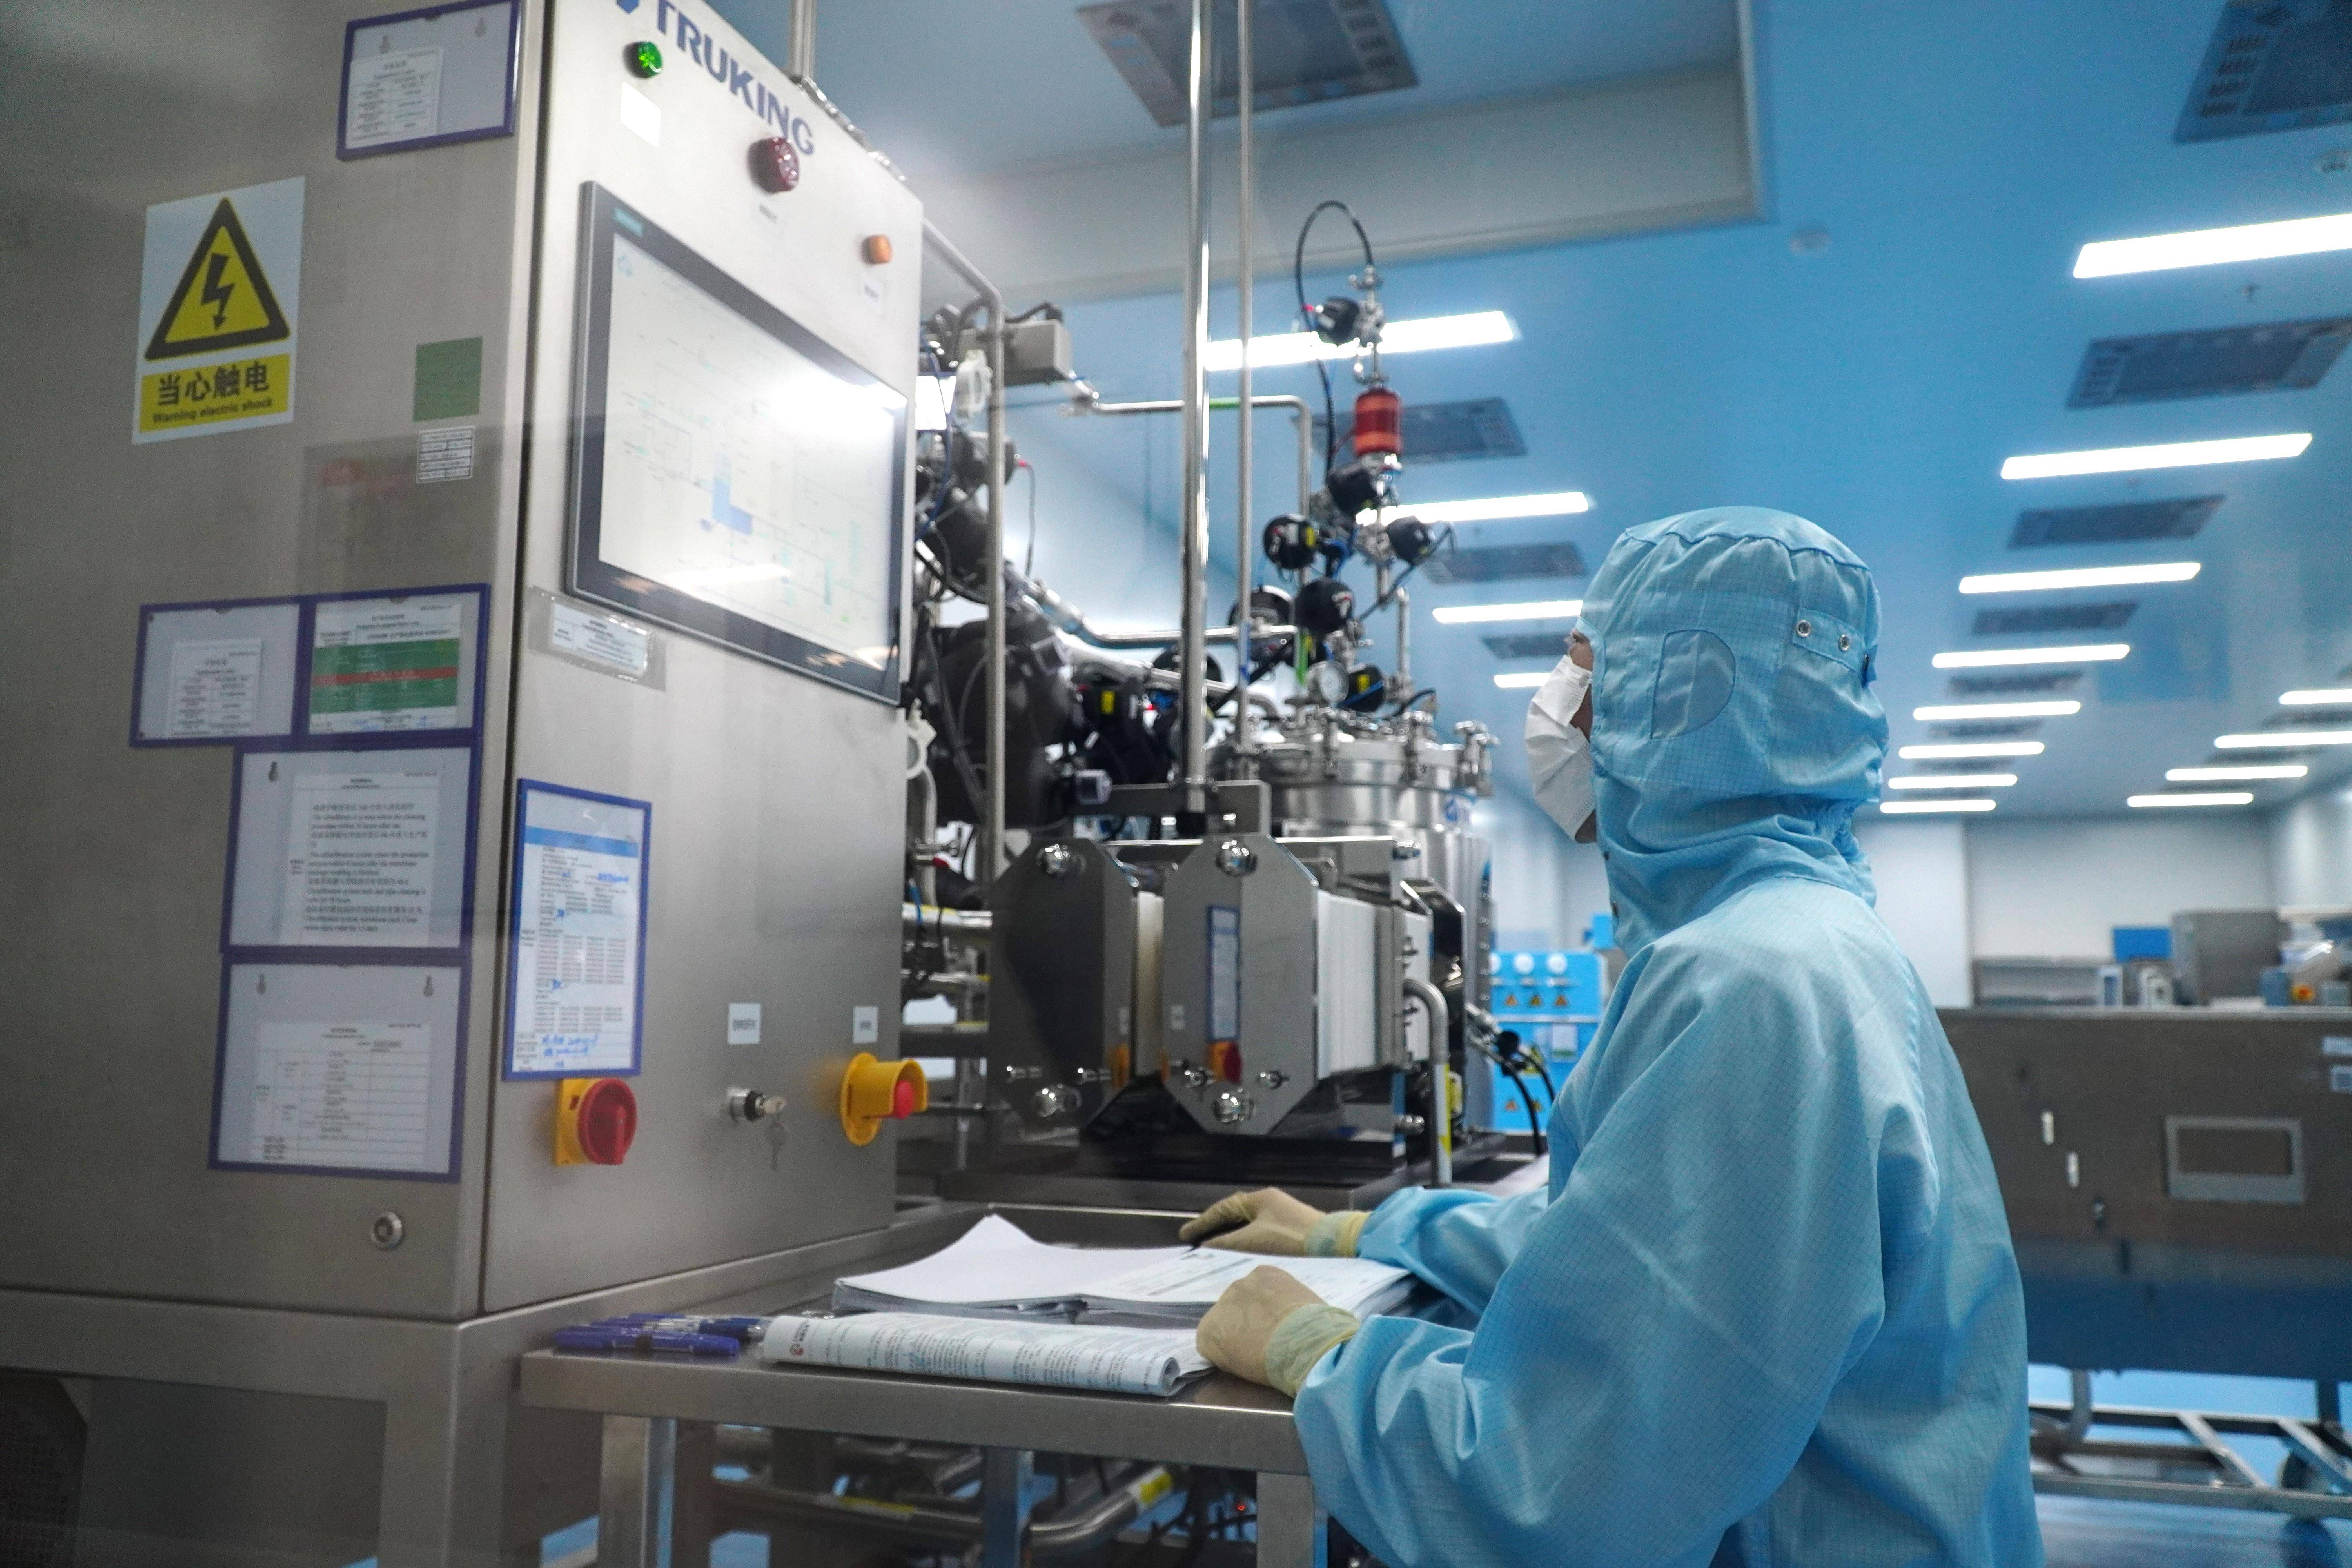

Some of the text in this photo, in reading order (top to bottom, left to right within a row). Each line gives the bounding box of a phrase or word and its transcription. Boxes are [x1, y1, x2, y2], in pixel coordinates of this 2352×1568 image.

[657, 0, 814, 156] TRUKING
[158, 360, 270, 406] 当心触电
[153, 409, 196, 423] Warning
